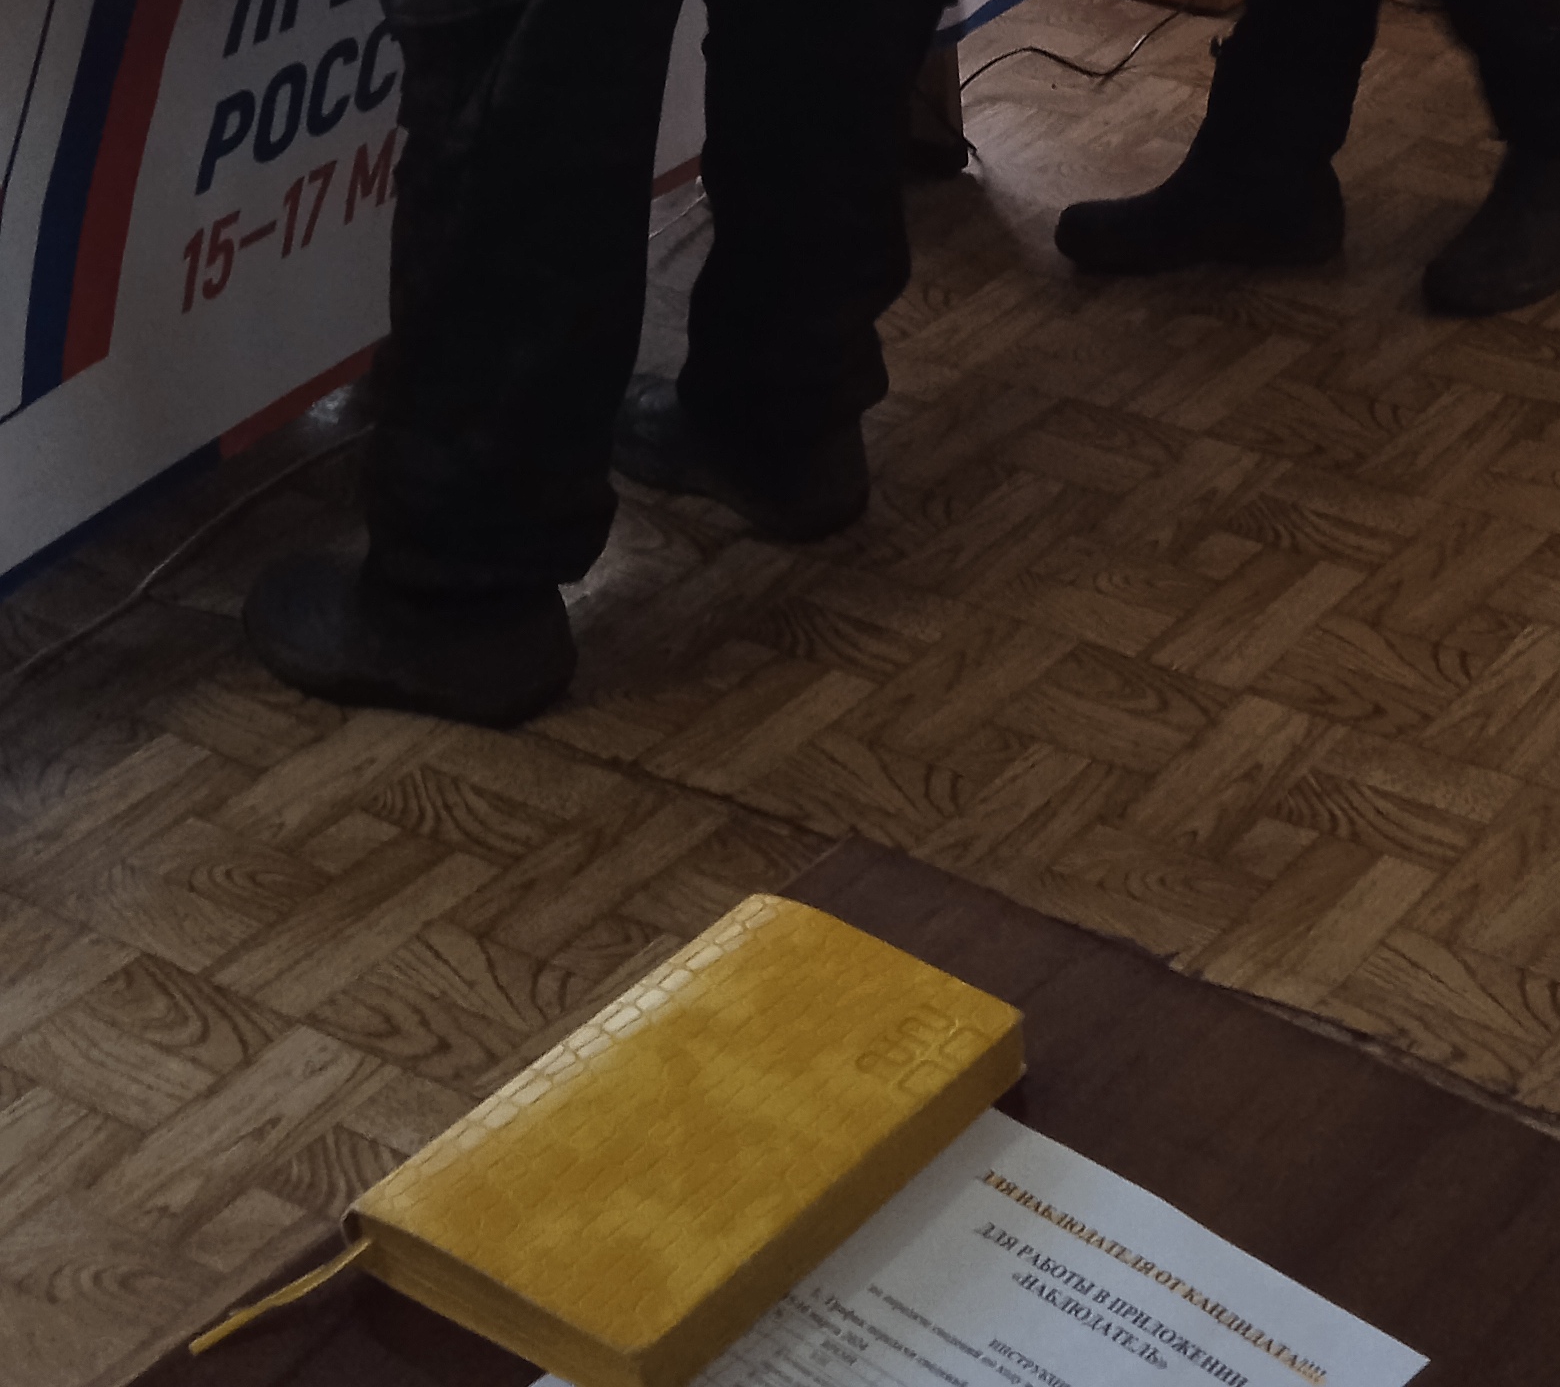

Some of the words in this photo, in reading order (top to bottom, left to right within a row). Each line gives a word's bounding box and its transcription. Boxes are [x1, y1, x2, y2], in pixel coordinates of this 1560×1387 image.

[343, 128, 398, 226] М
[1014, 1189, 1157, 1277] НАБЛЮДАТЕЛЯ
[1154, 1269, 1185, 1291] ОТ
[975, 1221, 1018, 1252] ДЛЯ
[1016, 1243, 1096, 1296] РАБОТЫ
[1091, 1287, 1110, 1305] В
[1107, 1296, 1249, 1387] ПРИЛОЖЕНИИ
[1011, 1272, 1168, 1370] «НАБЛЮДАТЕЛЬ»
